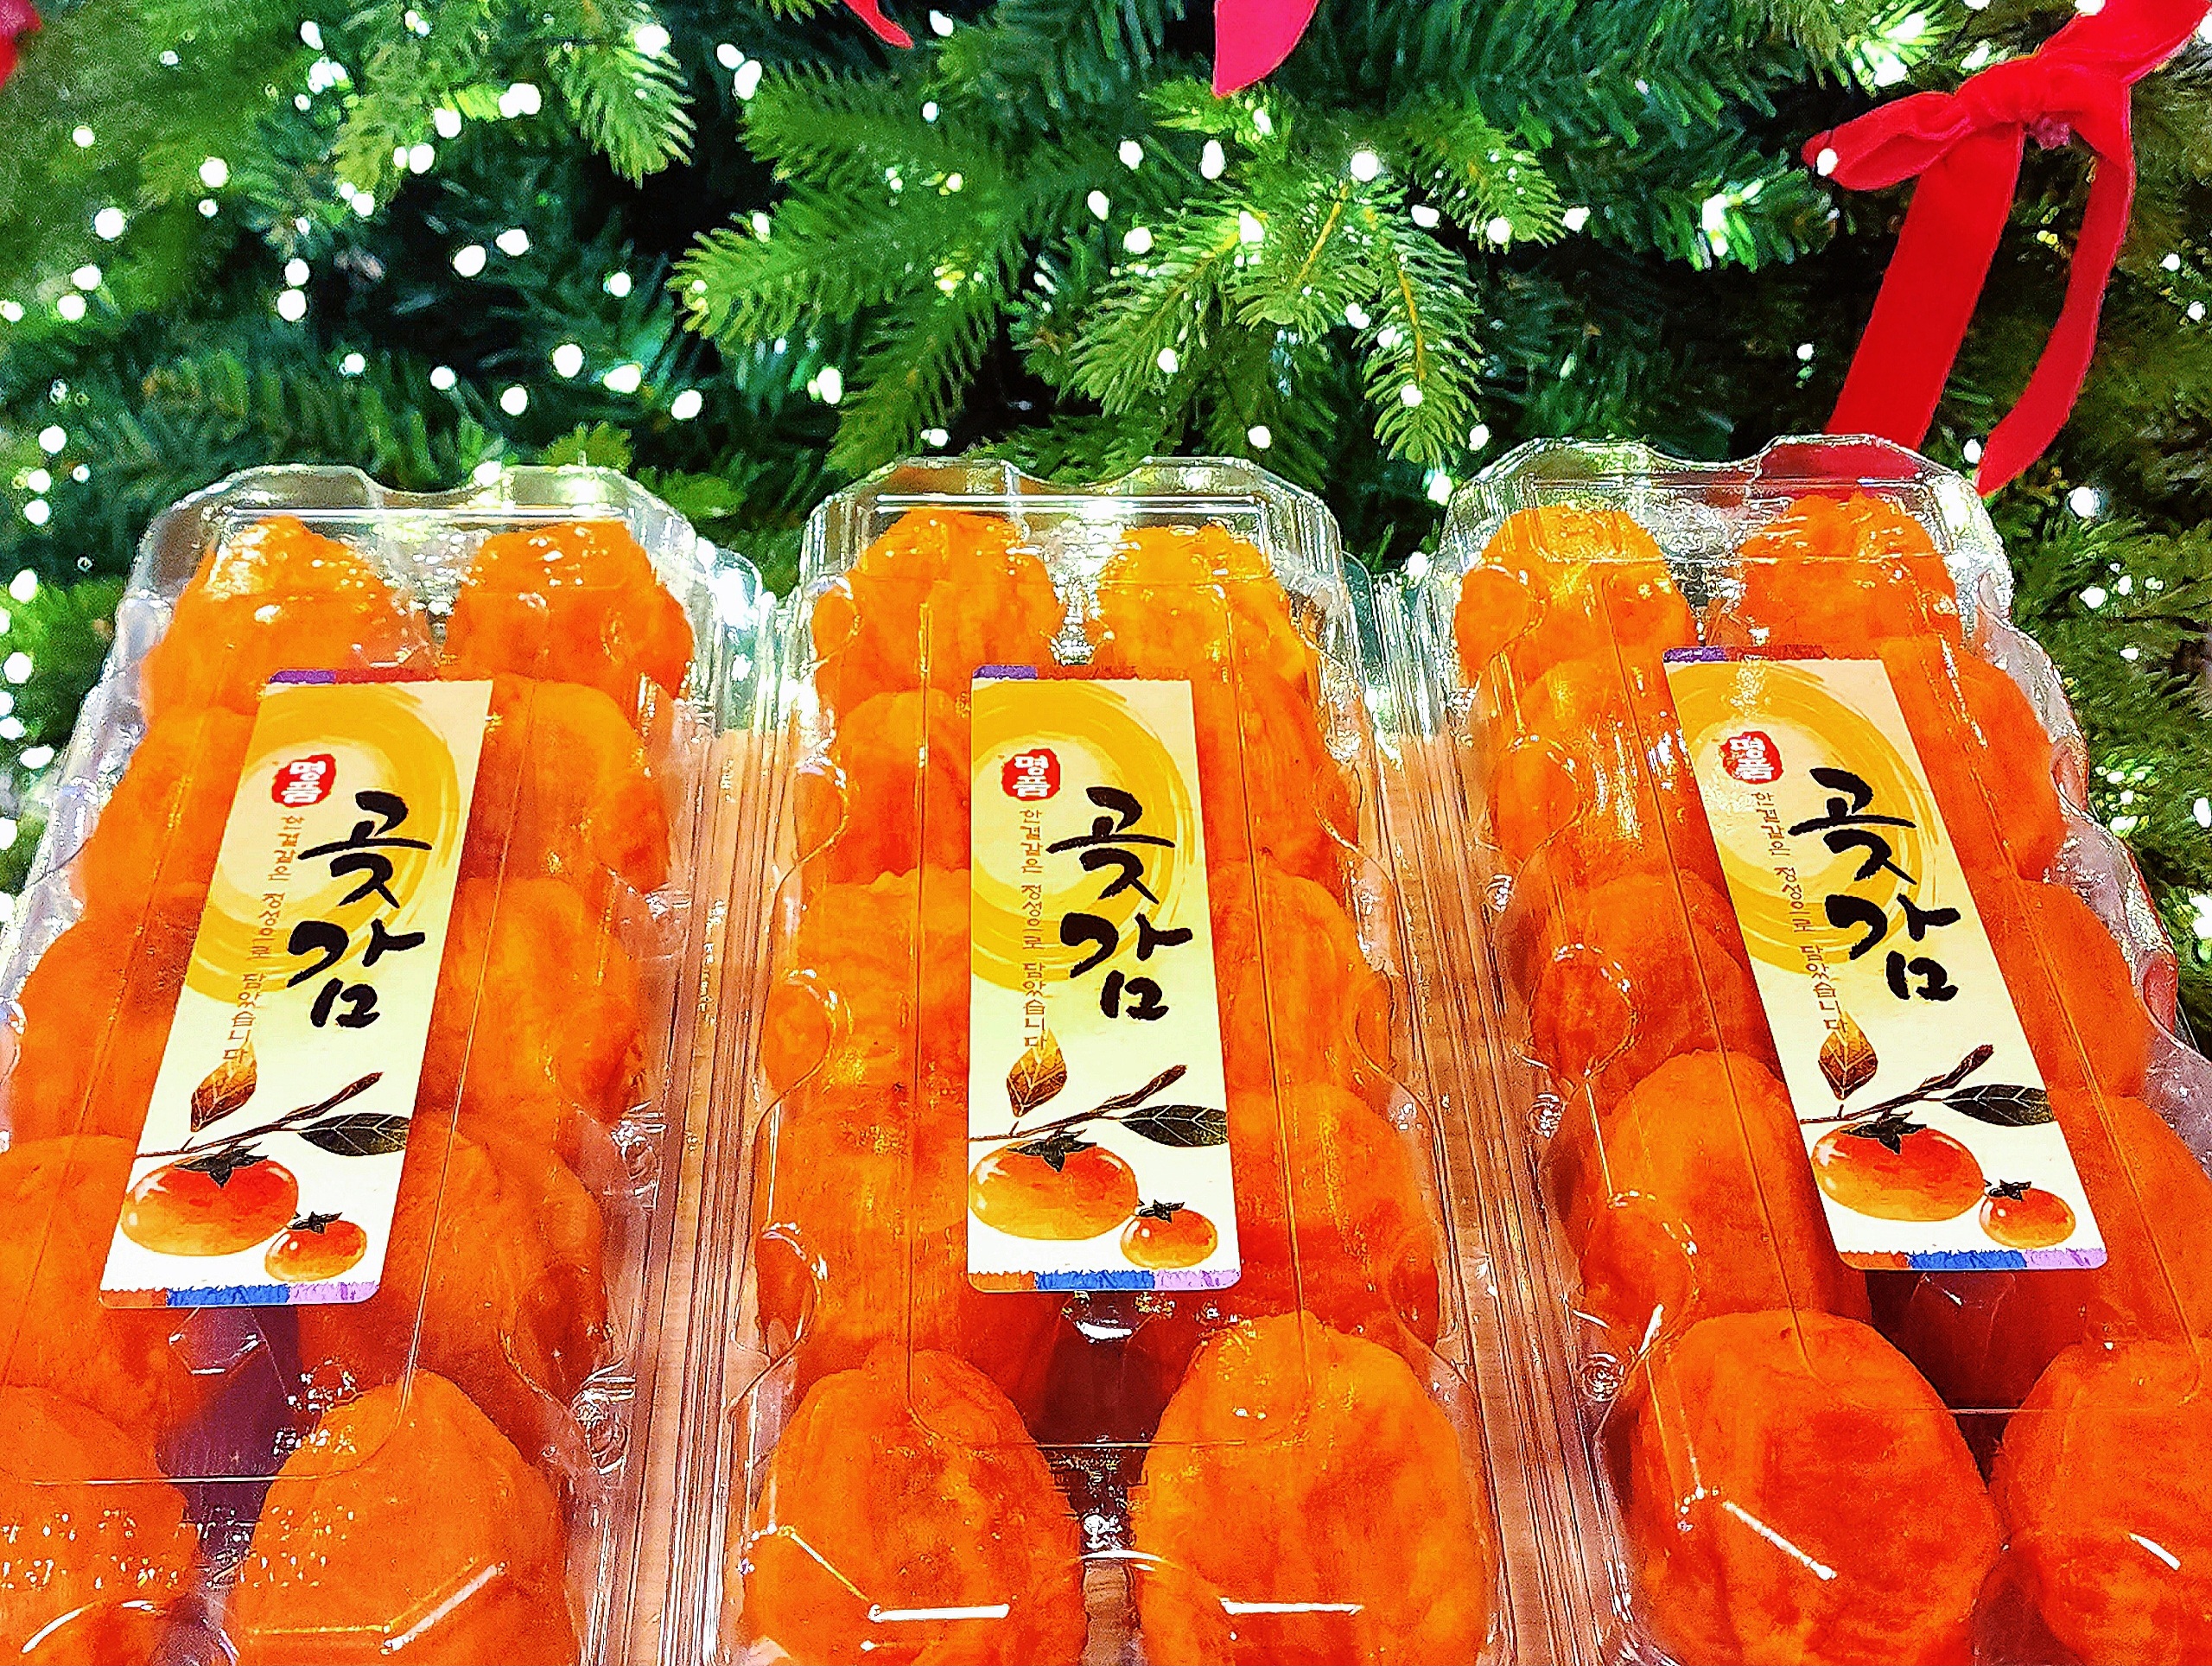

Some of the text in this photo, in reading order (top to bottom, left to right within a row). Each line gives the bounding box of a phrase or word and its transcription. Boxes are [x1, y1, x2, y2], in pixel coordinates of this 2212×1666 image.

[283, 760, 328, 804] 명품
[1013, 755, 1052, 798] 명품
[1730, 736, 1775, 781] 명품
[287, 791, 433, 1028] 곶감
[1046, 786, 1193, 1021] 곶감
[1788, 767, 1961, 1002] 곶감
[223, 973, 267, 1063] 담았습니다
[1022, 962, 1047, 1051] 담았습니다
[1800, 944, 1848, 1033] 담았습니다
